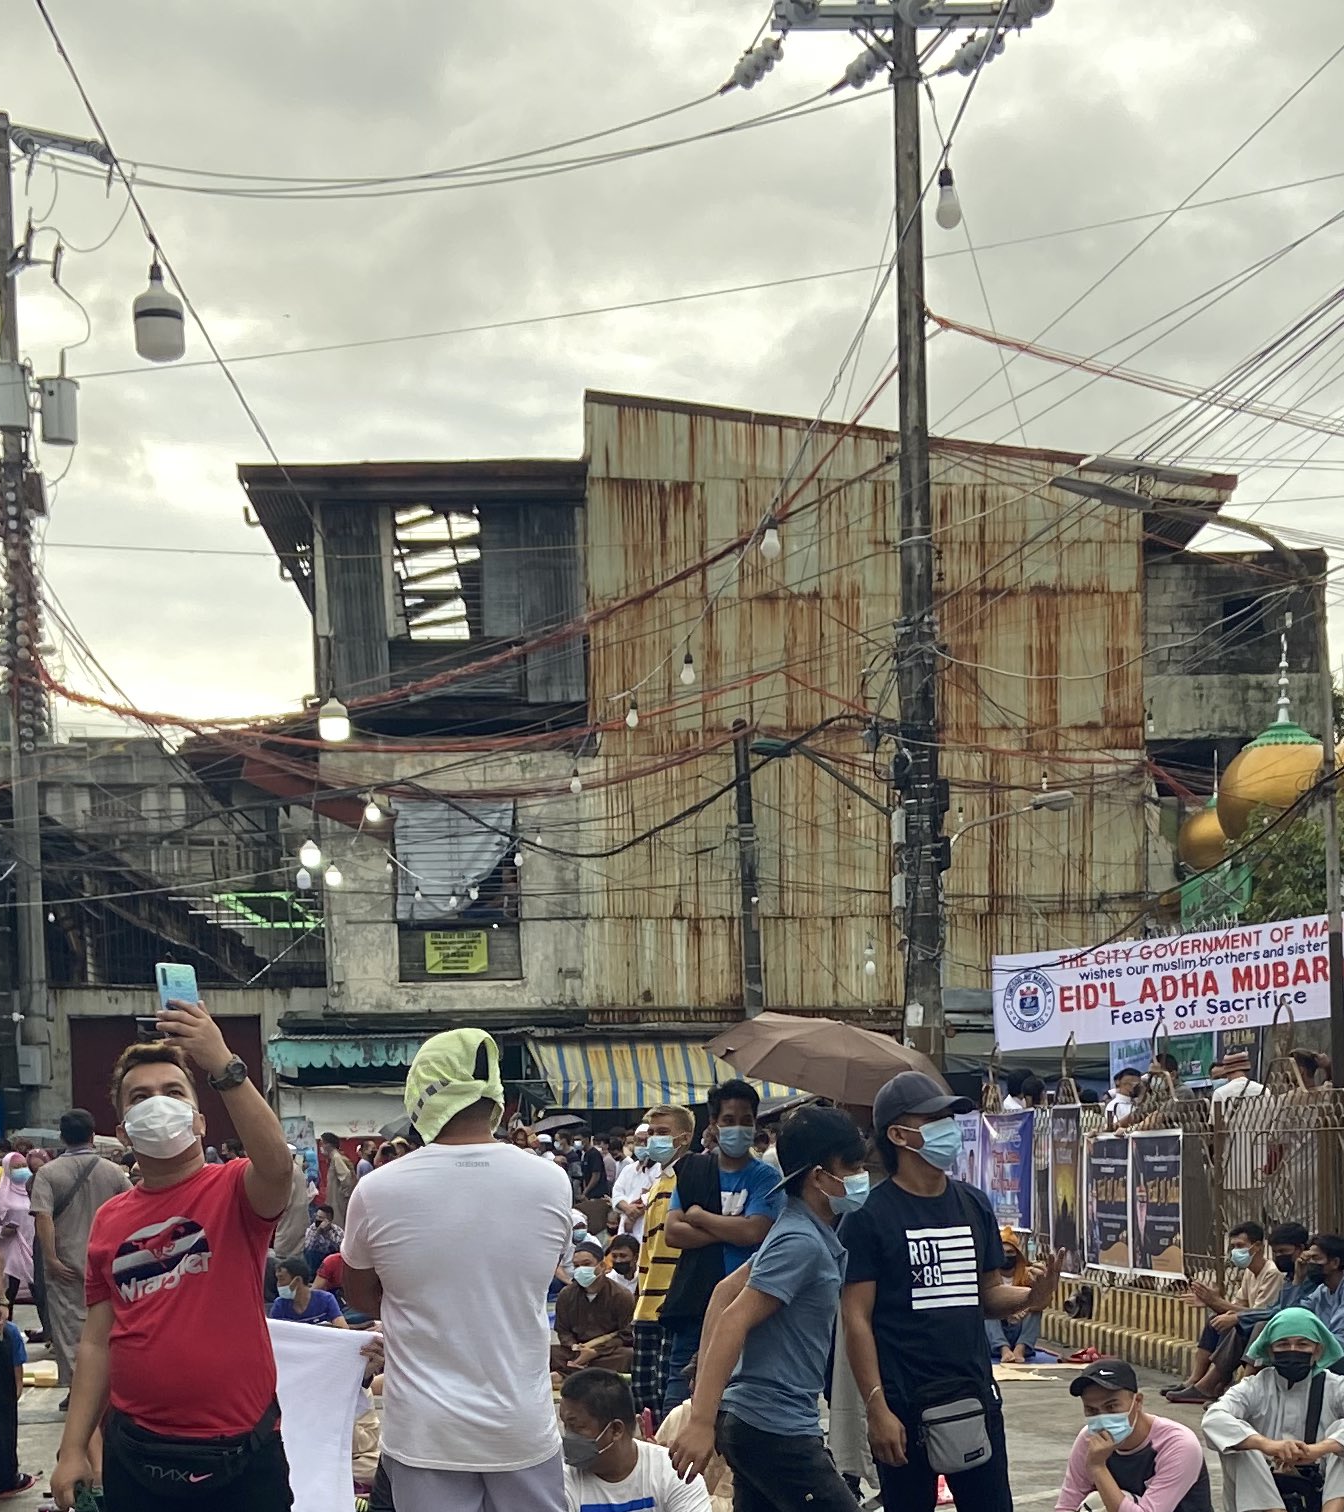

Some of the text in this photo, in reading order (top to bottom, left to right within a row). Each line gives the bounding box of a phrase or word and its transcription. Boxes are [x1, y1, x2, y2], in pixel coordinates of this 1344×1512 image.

[1079, 968, 1123, 981] wishes
[1127, 965, 1149, 976] our
[1152, 956, 1197, 974] muslim
[1199, 947, 1260, 967] brothers
[1263, 944, 1284, 959] and
[1094, 947, 1133, 965] CITY
[1140, 929, 1262, 960] GOVERNMENT
[1270, 925, 1294, 943] OF
[1059, 981, 1126, 1013] EID'L
[1139, 970, 1220, 1005] ADHA
[1111, 990, 1307, 1026] Feast of Sacrifice
[1173, 1013, 1249, 1031] 20 JULY 2021
[907, 1240, 940, 1266] RGT
